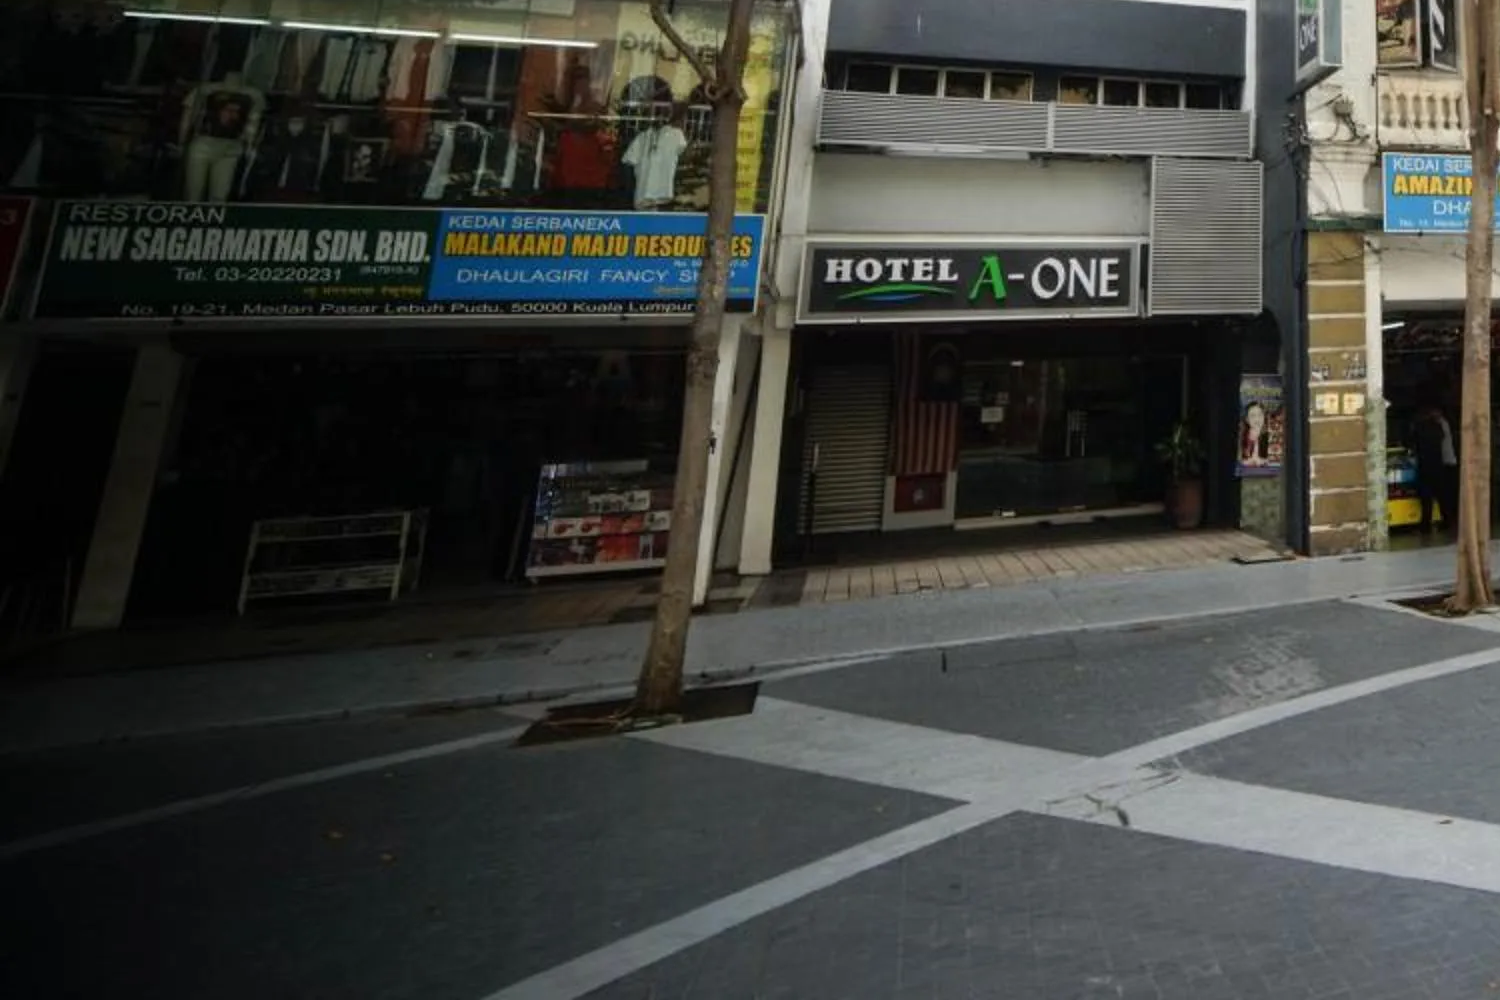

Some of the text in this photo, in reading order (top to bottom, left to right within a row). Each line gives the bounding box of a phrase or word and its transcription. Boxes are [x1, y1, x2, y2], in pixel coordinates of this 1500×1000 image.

[1392, 158, 1440, 173] KEDAI
[69, 203, 227, 224] RESTORAN
[448, 215, 622, 232] KEDAI SERBANEKA
[60, 226, 431, 263] NEW SAGARMATHA SDN. BHD.
[444, 232, 753, 258] MALAKAND MAJU RESOUES
[175, 266, 208, 281] Tel.
[214, 267, 342, 282] 03-20220231
[456, 268, 589, 284] DHAULAGIRI
[601, 269, 670, 284] FANCY
[824, 255, 1120, 300] HOTEL A-ONE
[121, 302, 152, 316] No.
[243, 301, 316, 316] Medan
[319, 301, 378, 315] Pasar
[383, 301, 447, 315] Lebuh
[510, 301, 568, 313] 50000
[573, 301, 624, 313] Kuala
